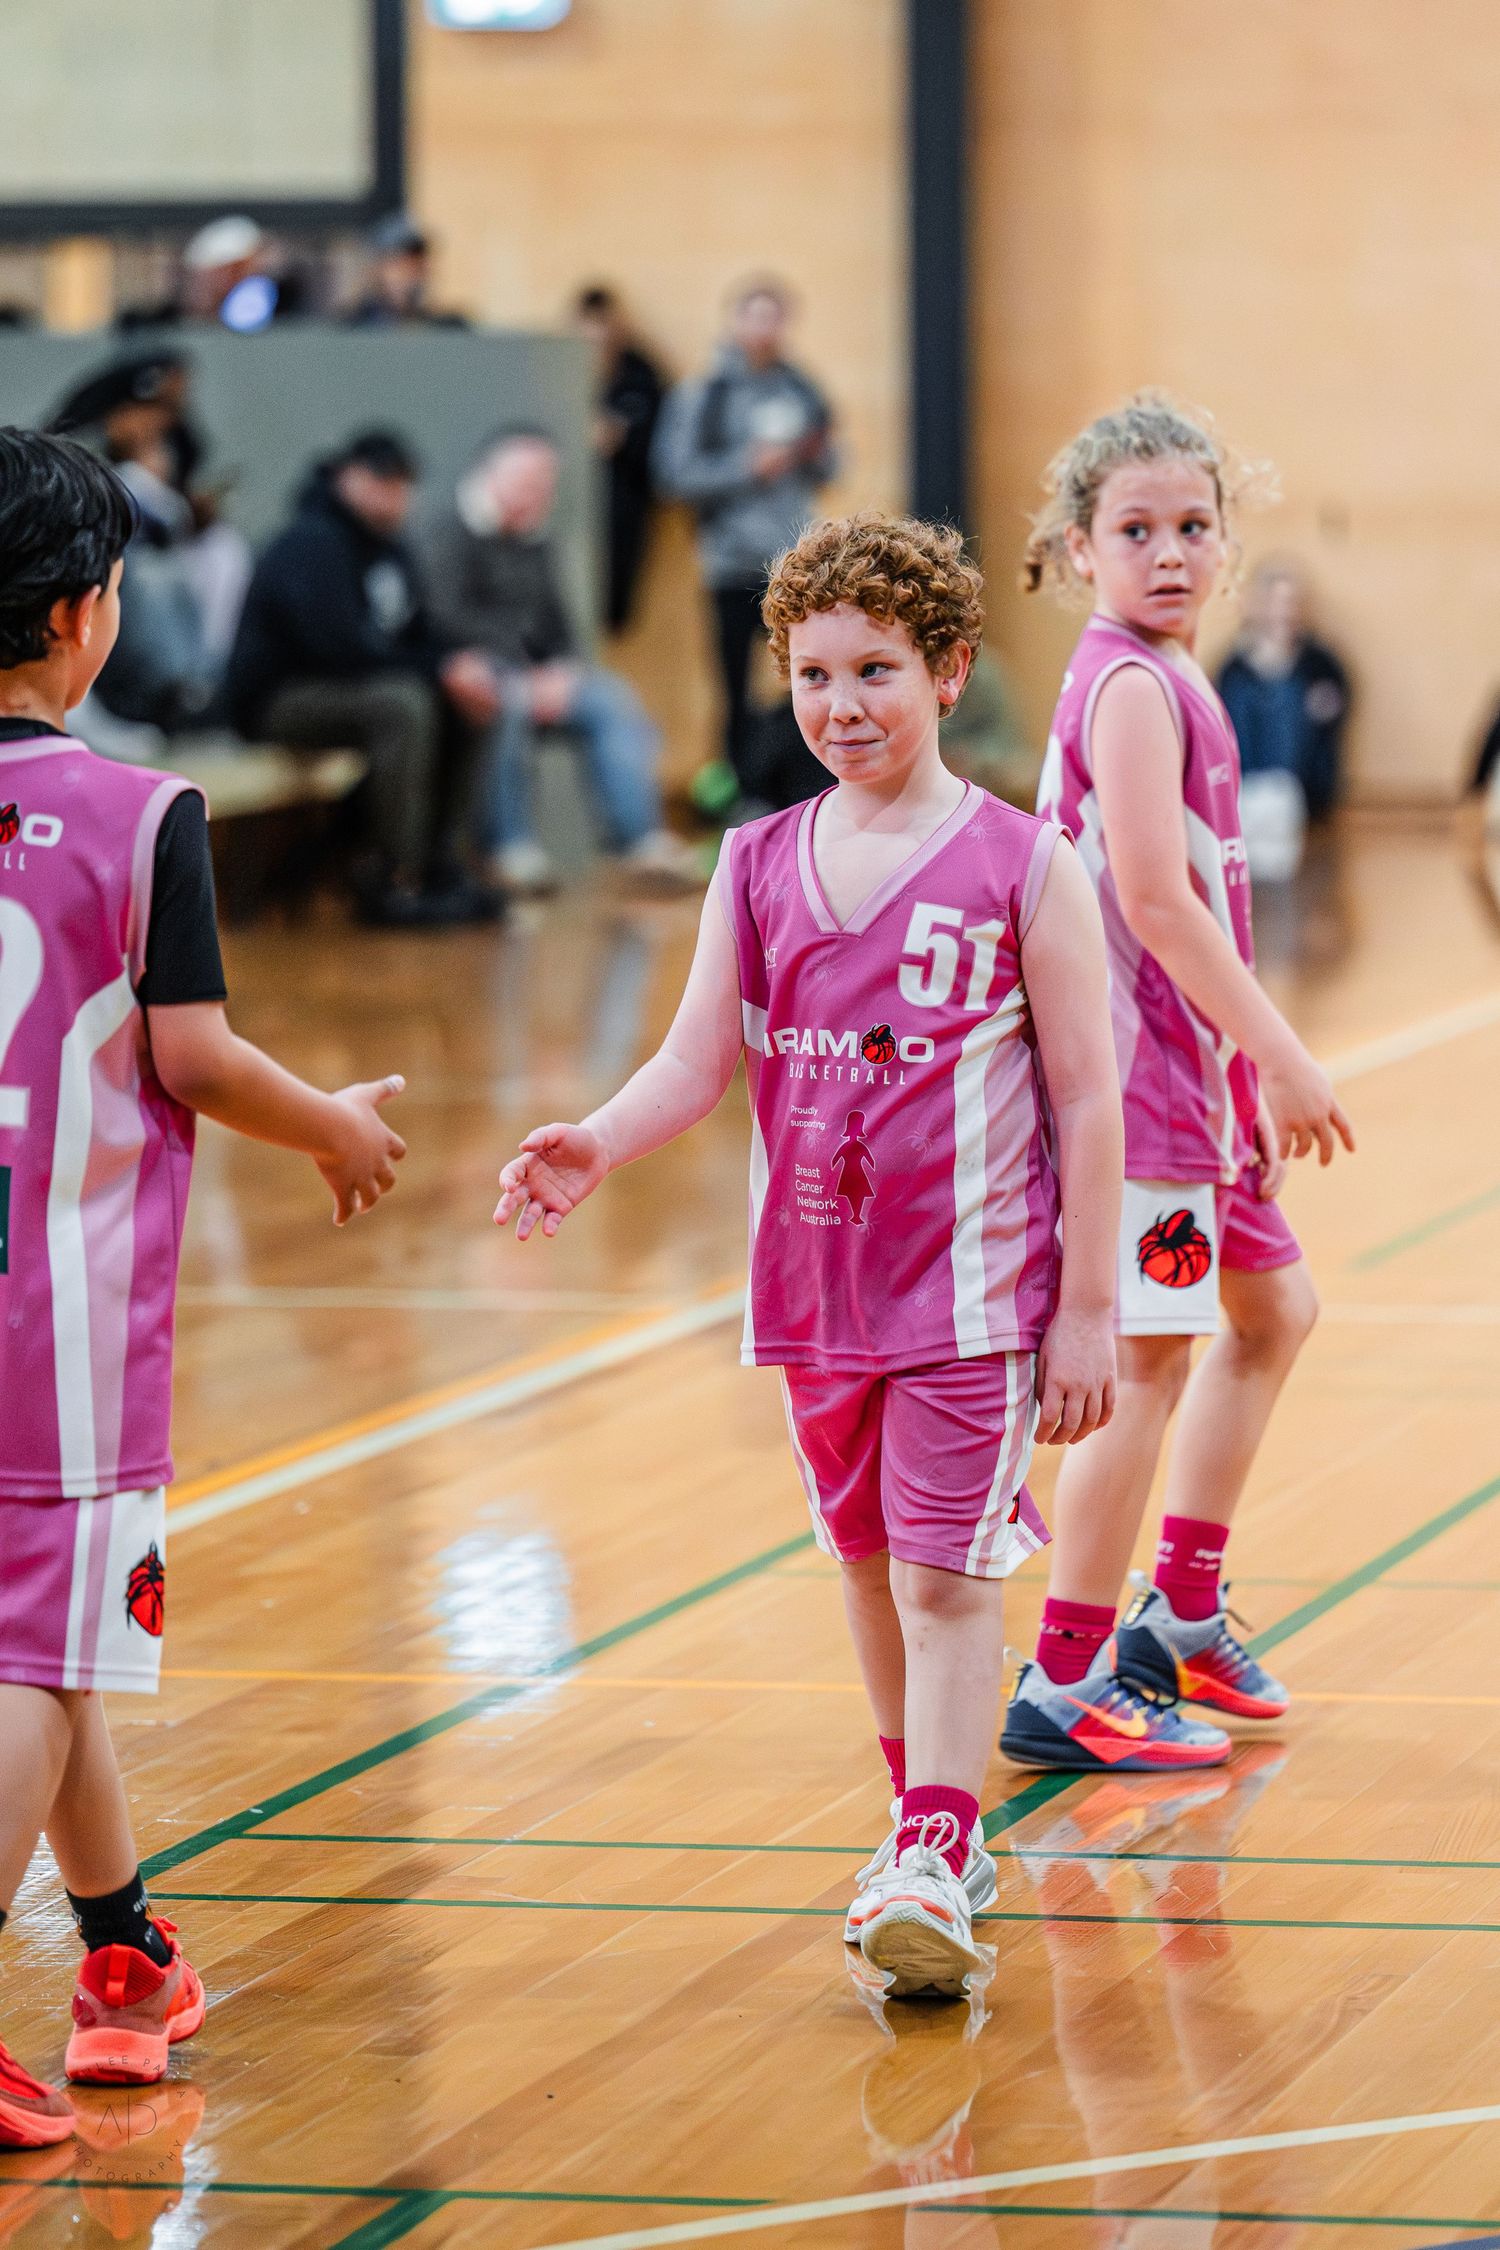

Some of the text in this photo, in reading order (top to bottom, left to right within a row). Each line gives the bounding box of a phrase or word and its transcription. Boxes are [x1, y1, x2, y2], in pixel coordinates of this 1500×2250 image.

[898, 901, 1006, 1011] 51
[790, 1105, 818, 1116] Proudly
[790, 1119, 826, 1130] supporting
[795, 1164, 820, 1178] Breast
[795, 1180, 824, 1194] Cancer
[797, 1195, 838, 1210] Network
[800, 1212, 841, 1225] Australia
